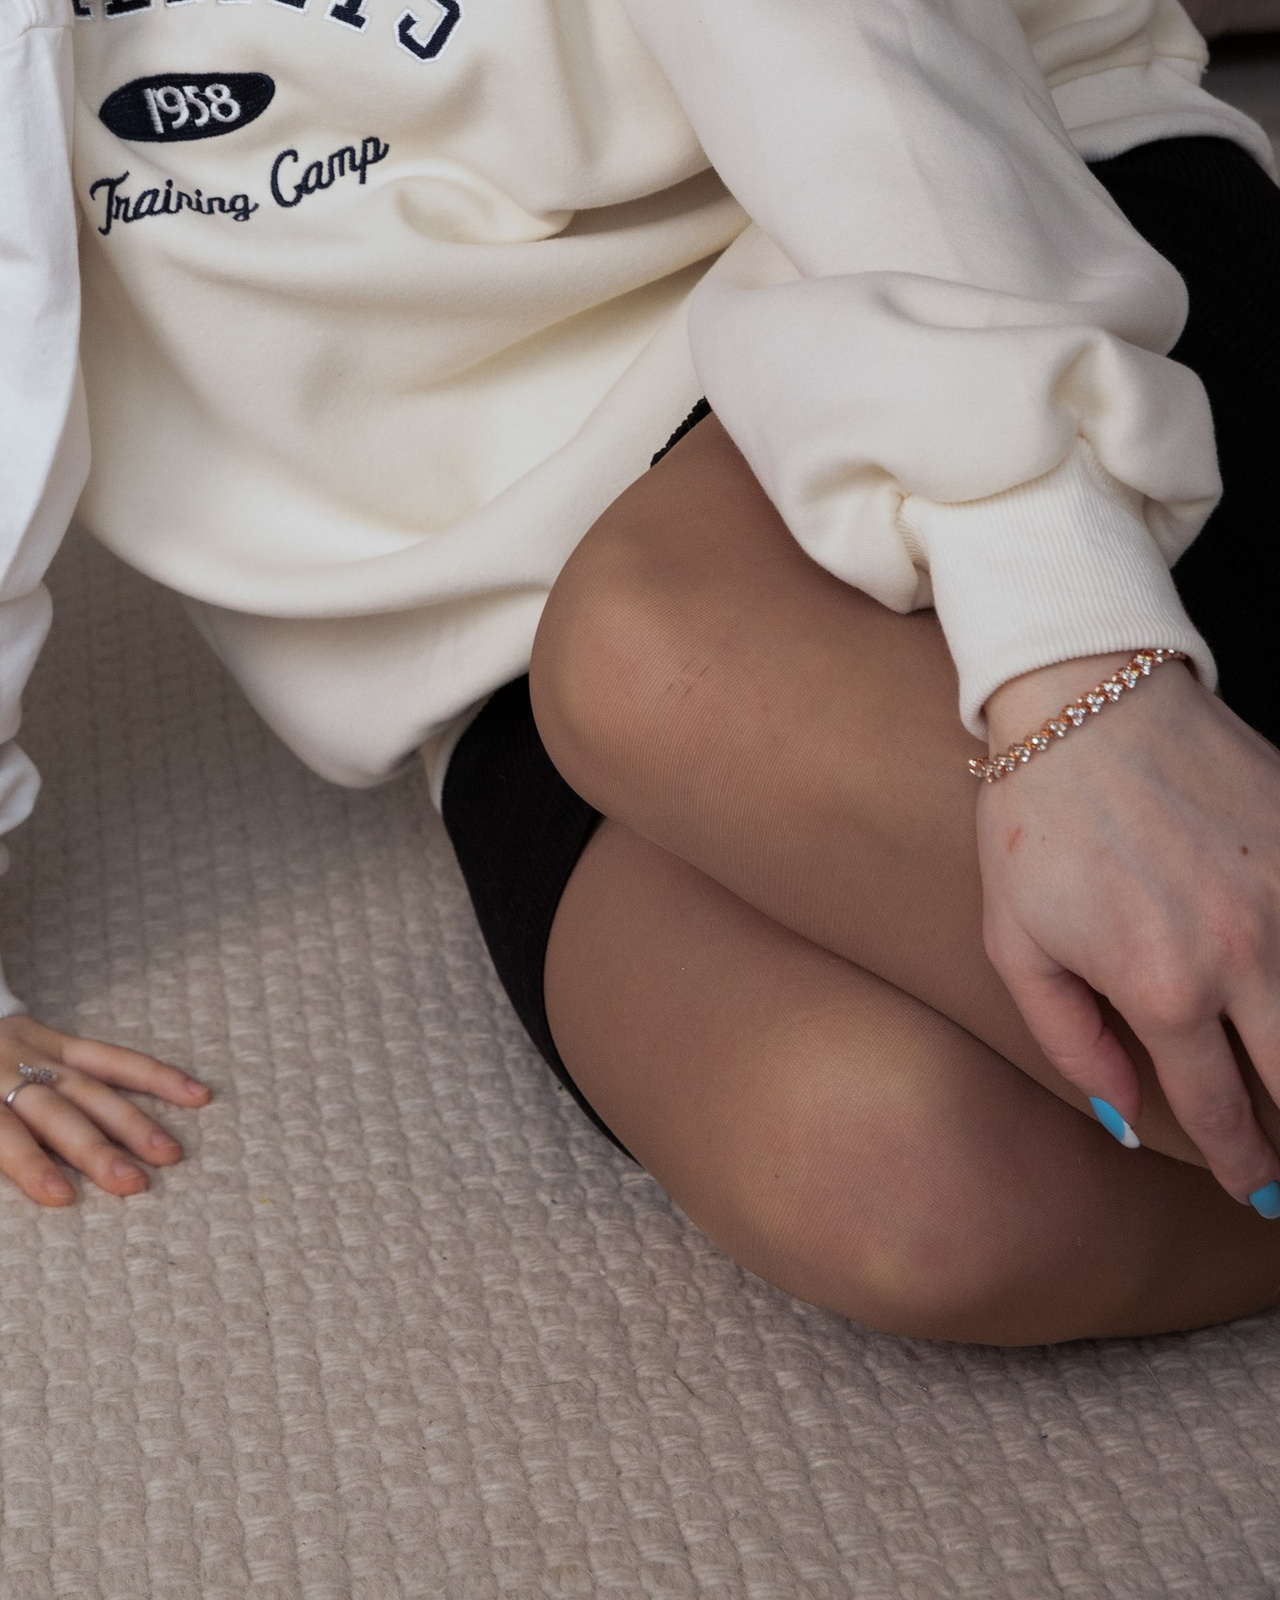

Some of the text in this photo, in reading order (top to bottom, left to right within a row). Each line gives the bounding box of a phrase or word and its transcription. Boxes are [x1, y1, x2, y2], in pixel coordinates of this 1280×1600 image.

[144, 83, 241, 135] 1958
[89, 135, 390, 236] Training Camp
